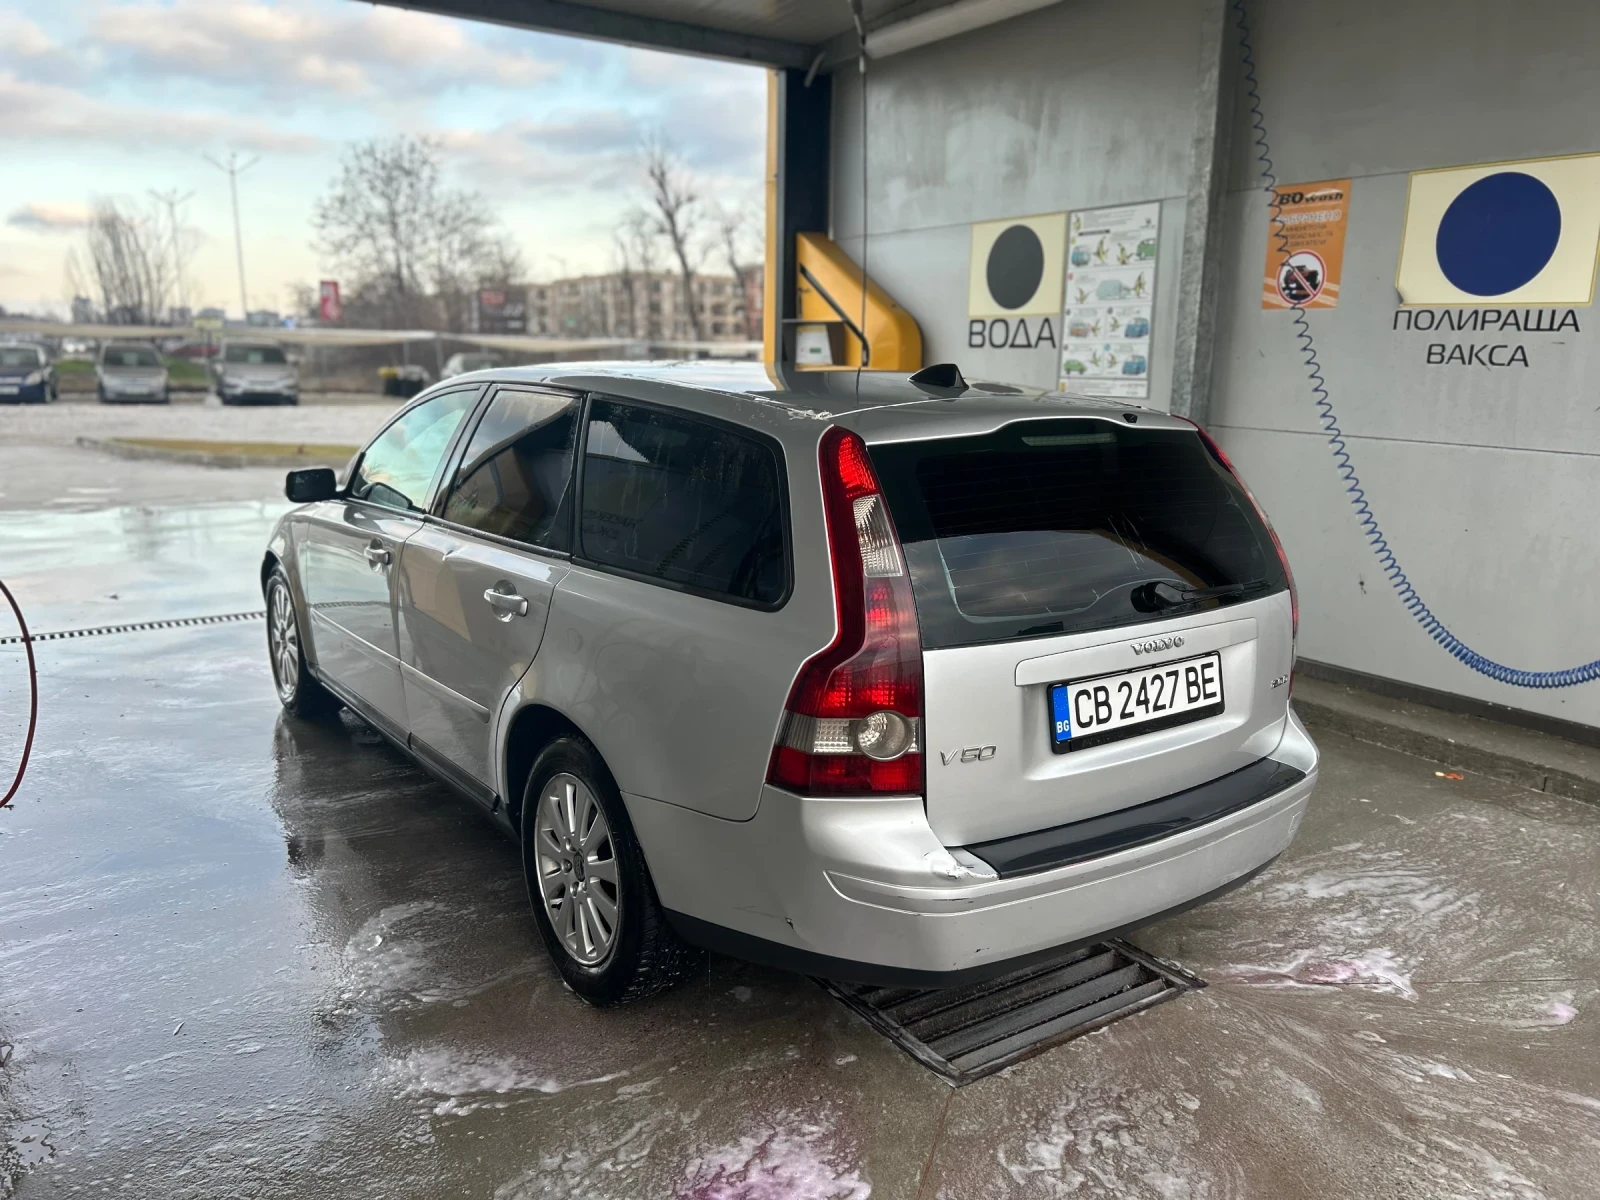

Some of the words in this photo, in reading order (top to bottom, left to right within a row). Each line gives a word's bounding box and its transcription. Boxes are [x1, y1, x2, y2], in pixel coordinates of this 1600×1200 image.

[968, 317, 1057, 349] ВОДА
[1392, 309, 1581, 333] ПОЛИРАША
[1426, 343, 1529, 368] ВАКСА
[1130, 636, 1185, 656] VOLVO
[1074, 685, 1112, 729] CB
[1117, 669, 1180, 720] 2427
[1185, 661, 1218, 705] BE
[1056, 720, 1070, 734] BG
